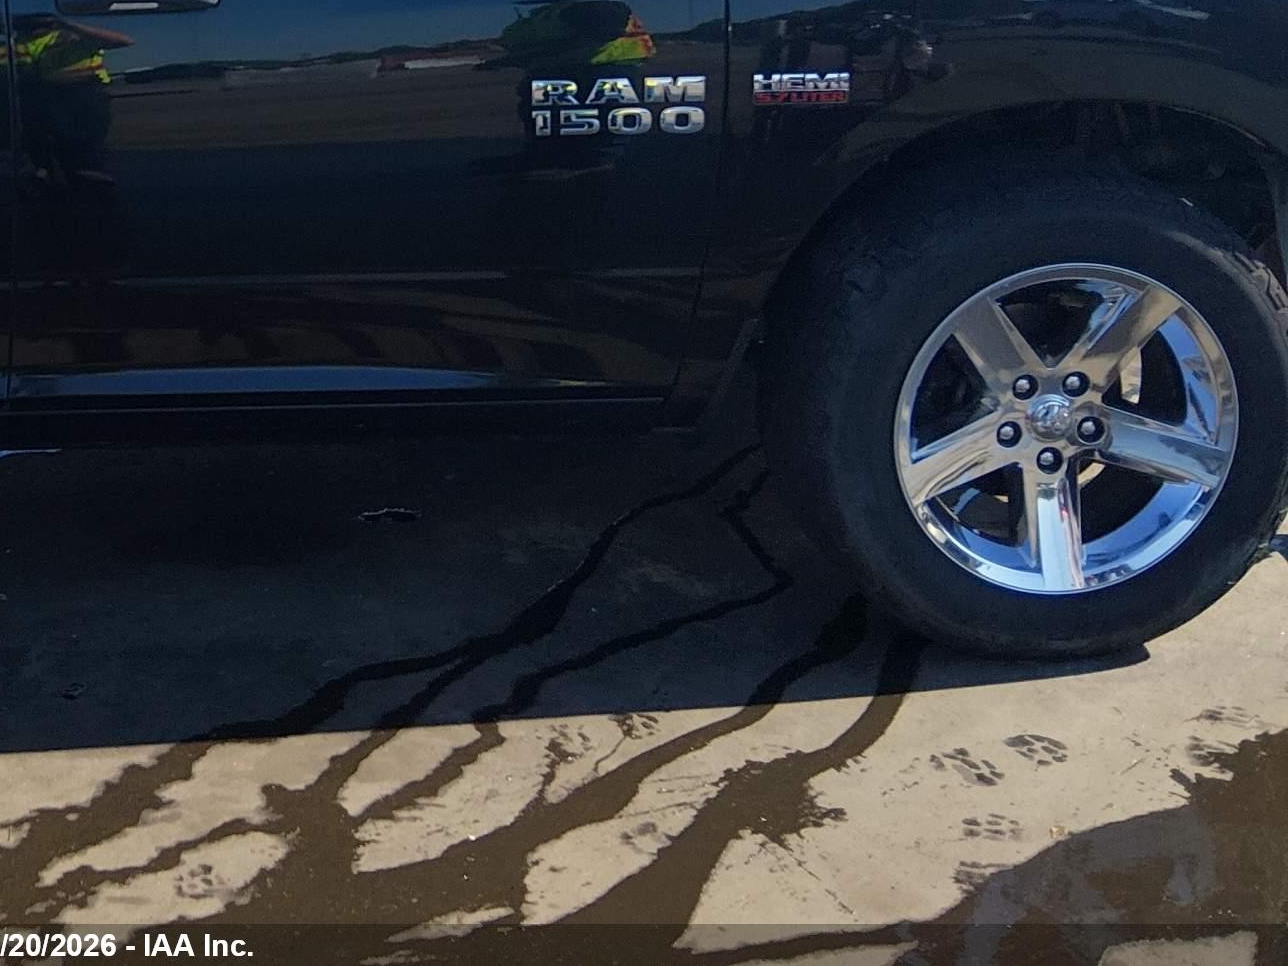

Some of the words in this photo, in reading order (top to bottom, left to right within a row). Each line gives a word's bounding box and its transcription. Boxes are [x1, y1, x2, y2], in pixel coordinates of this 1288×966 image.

[531, 76, 706, 106] RAM
[753, 72, 850, 91] HEMI
[531, 106, 705, 136] 1500
